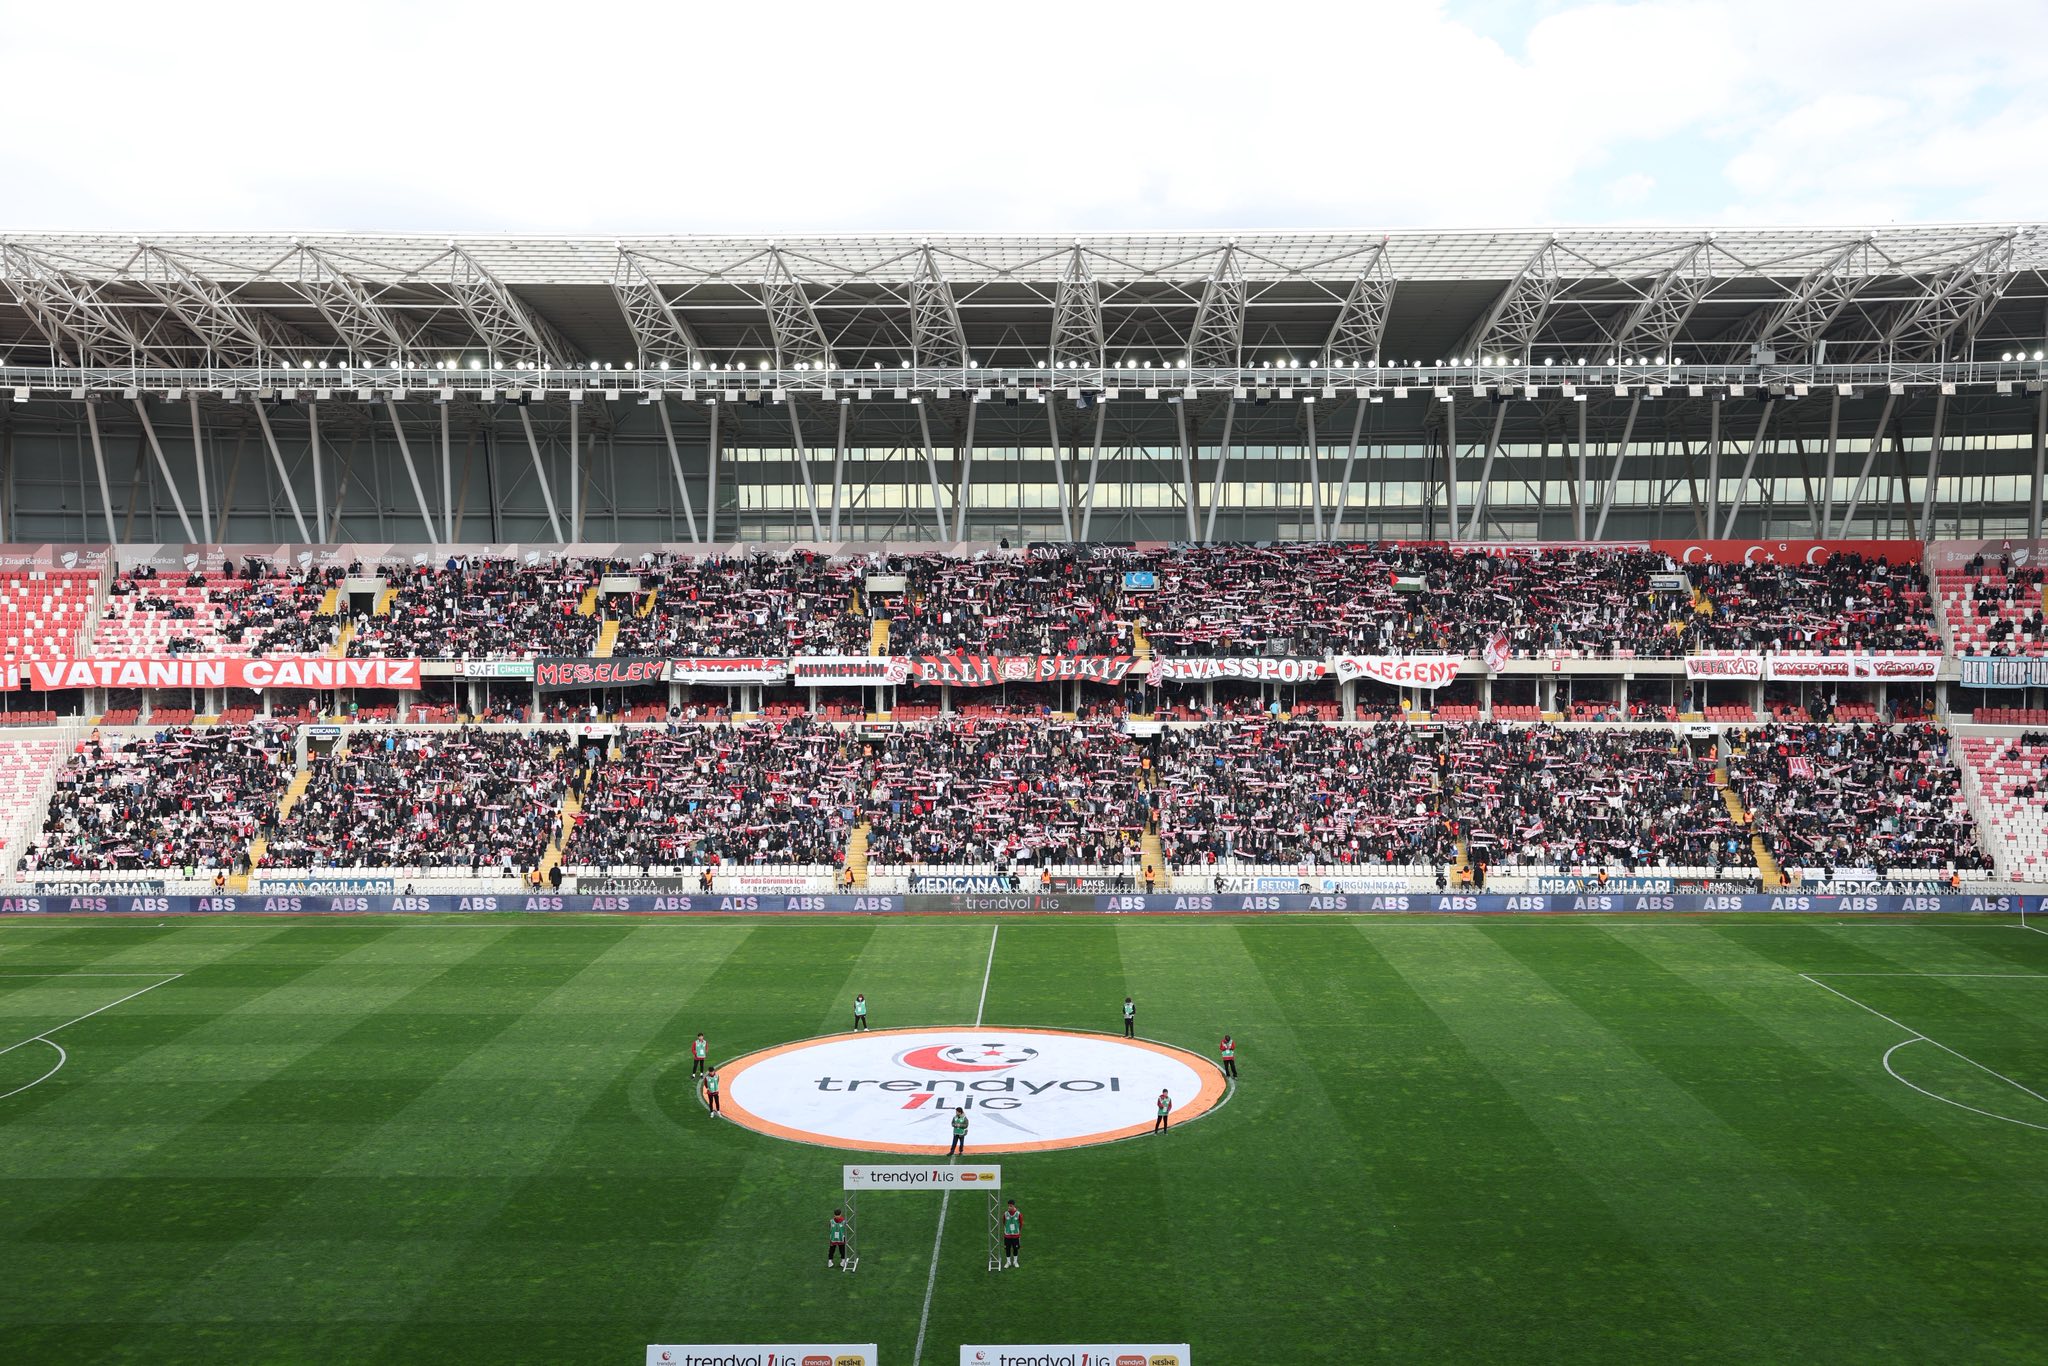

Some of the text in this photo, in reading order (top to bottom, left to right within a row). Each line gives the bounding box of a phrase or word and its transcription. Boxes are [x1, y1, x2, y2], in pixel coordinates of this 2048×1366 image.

[1779, 543, 1787, 552] G
[2003, 541, 2010, 549] A
[5, 557, 25, 565] Ziraat
[456, 663, 463, 672] B
[1366, 660, 1460, 683] LEGEND
[1553, 662, 1559, 670] F
[1963, 661, 1988, 684] BEN
[35, 661, 225, 687] VATANIN
[242, 660, 413, 686] CANIYIZ
[2, 898, 40, 911] ABS
[70, 898, 107, 911] ABS
[131, 898, 168, 911] ABS
[198, 898, 235, 911] ABS
[265, 898, 301, 911] ABS
[332, 898, 368, 911] ABS
[392, 898, 429, 911] ABS
[460, 898, 496, 911] ABS
[526, 898, 563, 911] ABS
[592, 898, 629, 911] ABS
[654, 898, 691, 911] ABS
[721, 898, 758, 911] ABS
[787, 898, 825, 911] ABS
[854, 898, 892, 911] ABS
[965, 897, 1031, 910] trendyol
[1108, 897, 1145, 910] ABS
[1175, 897, 1212, 910] ABS
[1242, 897, 1280, 910] ABS
[1309, 897, 1347, 910] ABS
[1372, 897, 1409, 910] ABS
[1439, 897, 1477, 910] ABS
[1507, 897, 1544, 910] ABS
[1574, 897, 1611, 910] ABS
[1637, 897, 1674, 910] ABS
[1704, 897, 1741, 910] ABS
[1771, 897, 1809, 910] ABS
[1839, 897, 1877, 910] ABS
[1902, 897, 1940, 910] ABS
[814, 1077, 1120, 1095] trendyol
[870, 1171, 927, 1184] trendyol
